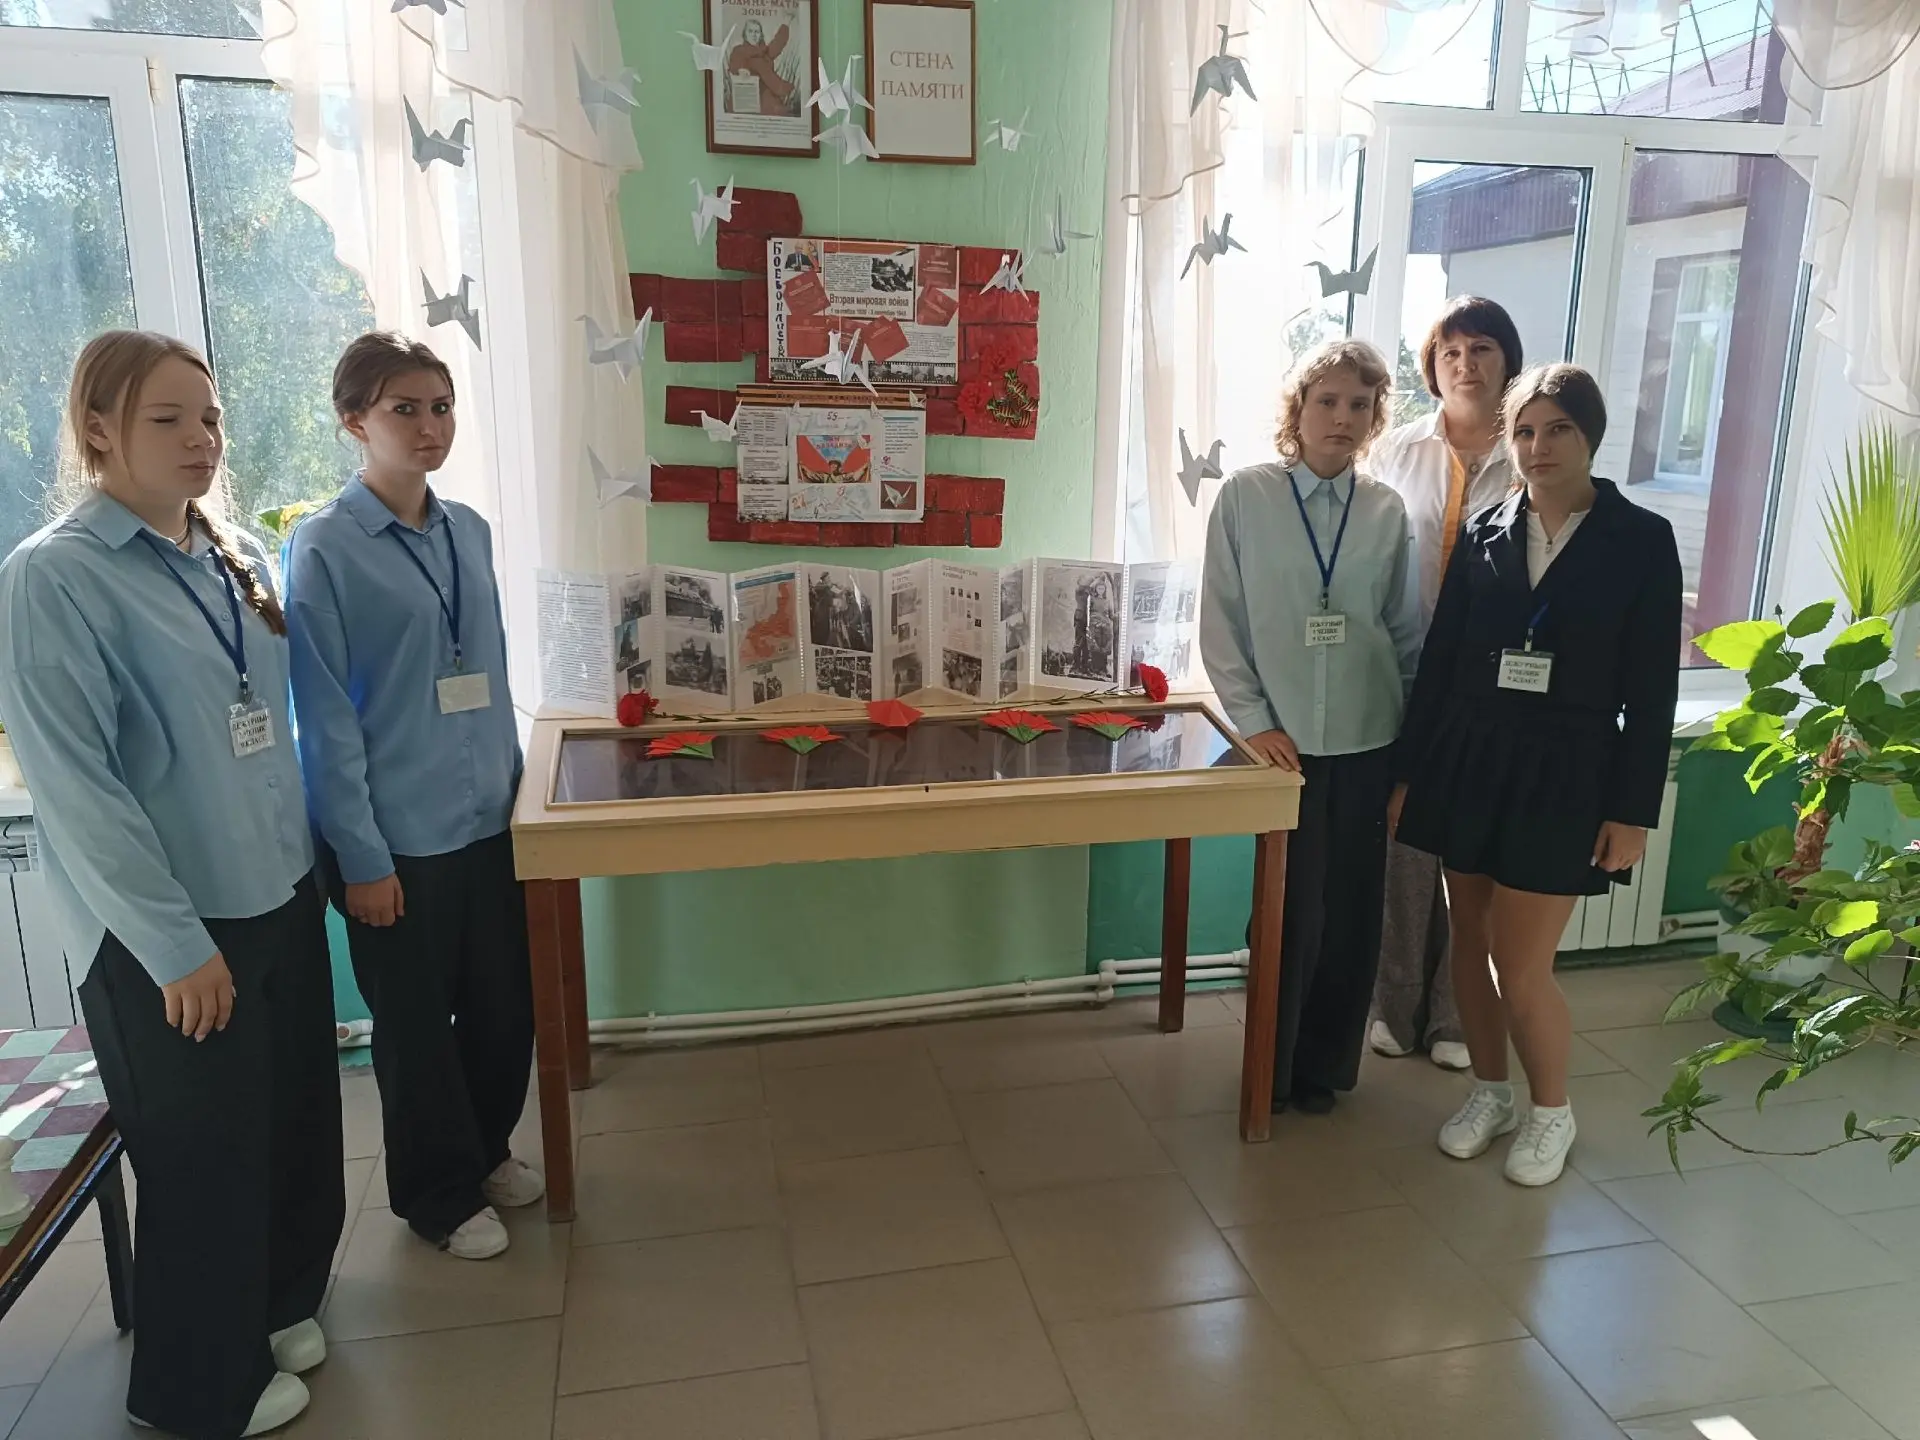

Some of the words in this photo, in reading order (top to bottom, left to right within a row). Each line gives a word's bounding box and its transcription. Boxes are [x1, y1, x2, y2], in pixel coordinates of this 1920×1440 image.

[889, 50, 955, 70] СТЕНА
[881, 80, 965, 100] ПАМЯТИ
[830, 293, 855, 306] Вторая
[856, 296, 887, 308] мировая
[888, 296, 909, 307] война
